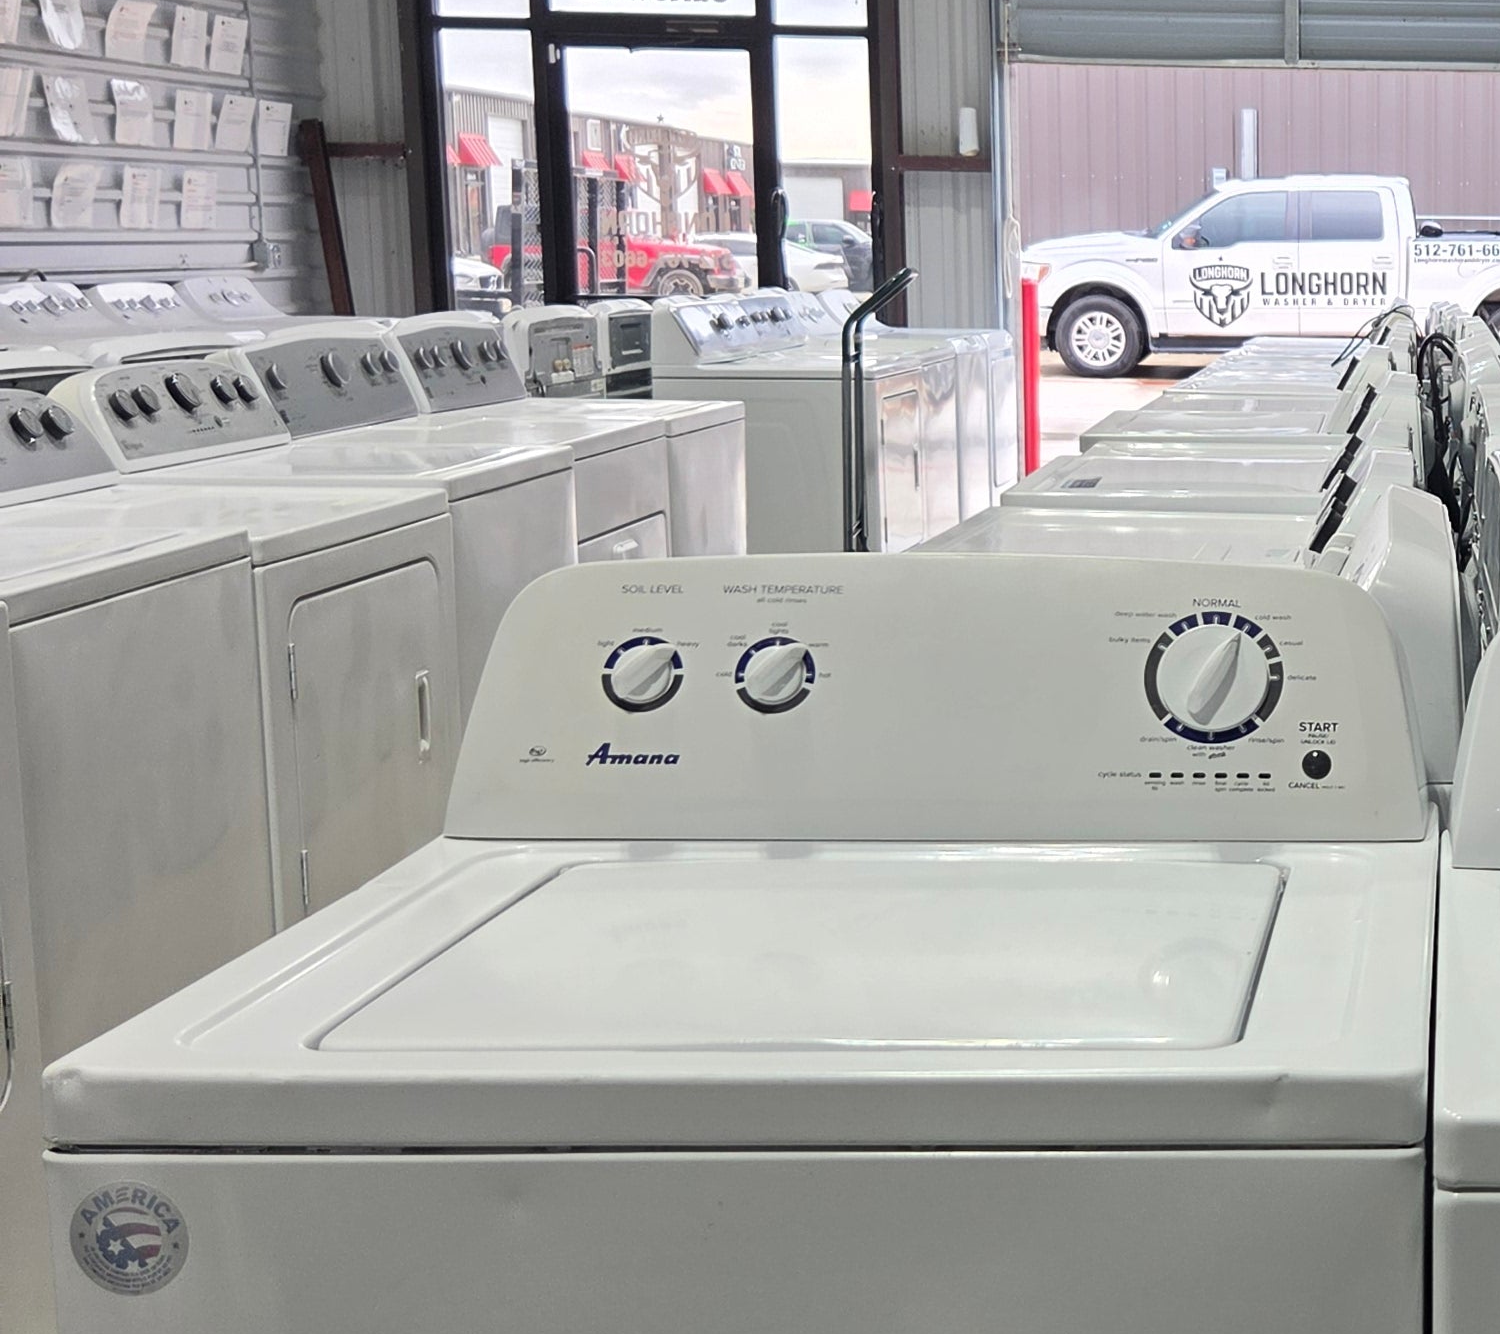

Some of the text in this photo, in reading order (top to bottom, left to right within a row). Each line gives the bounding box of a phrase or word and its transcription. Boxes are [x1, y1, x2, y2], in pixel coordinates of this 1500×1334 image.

[1195, 267, 1248, 282] LONGHORN
[1260, 272, 1387, 296] LONGHORN
[1263, 298, 1386, 306] WASHER & DRYER
[621, 584, 684, 594] SOIL LEVEL
[723, 584, 844, 595] WASH TEMPERATURE
[1193, 598, 1241, 608] NORMAL
[1298, 721, 1339, 732] START
[585, 742, 681, 766] Amana
[1288, 781, 1320, 789] CANCEL
[80, 1186, 181, 1235] AMERICA
